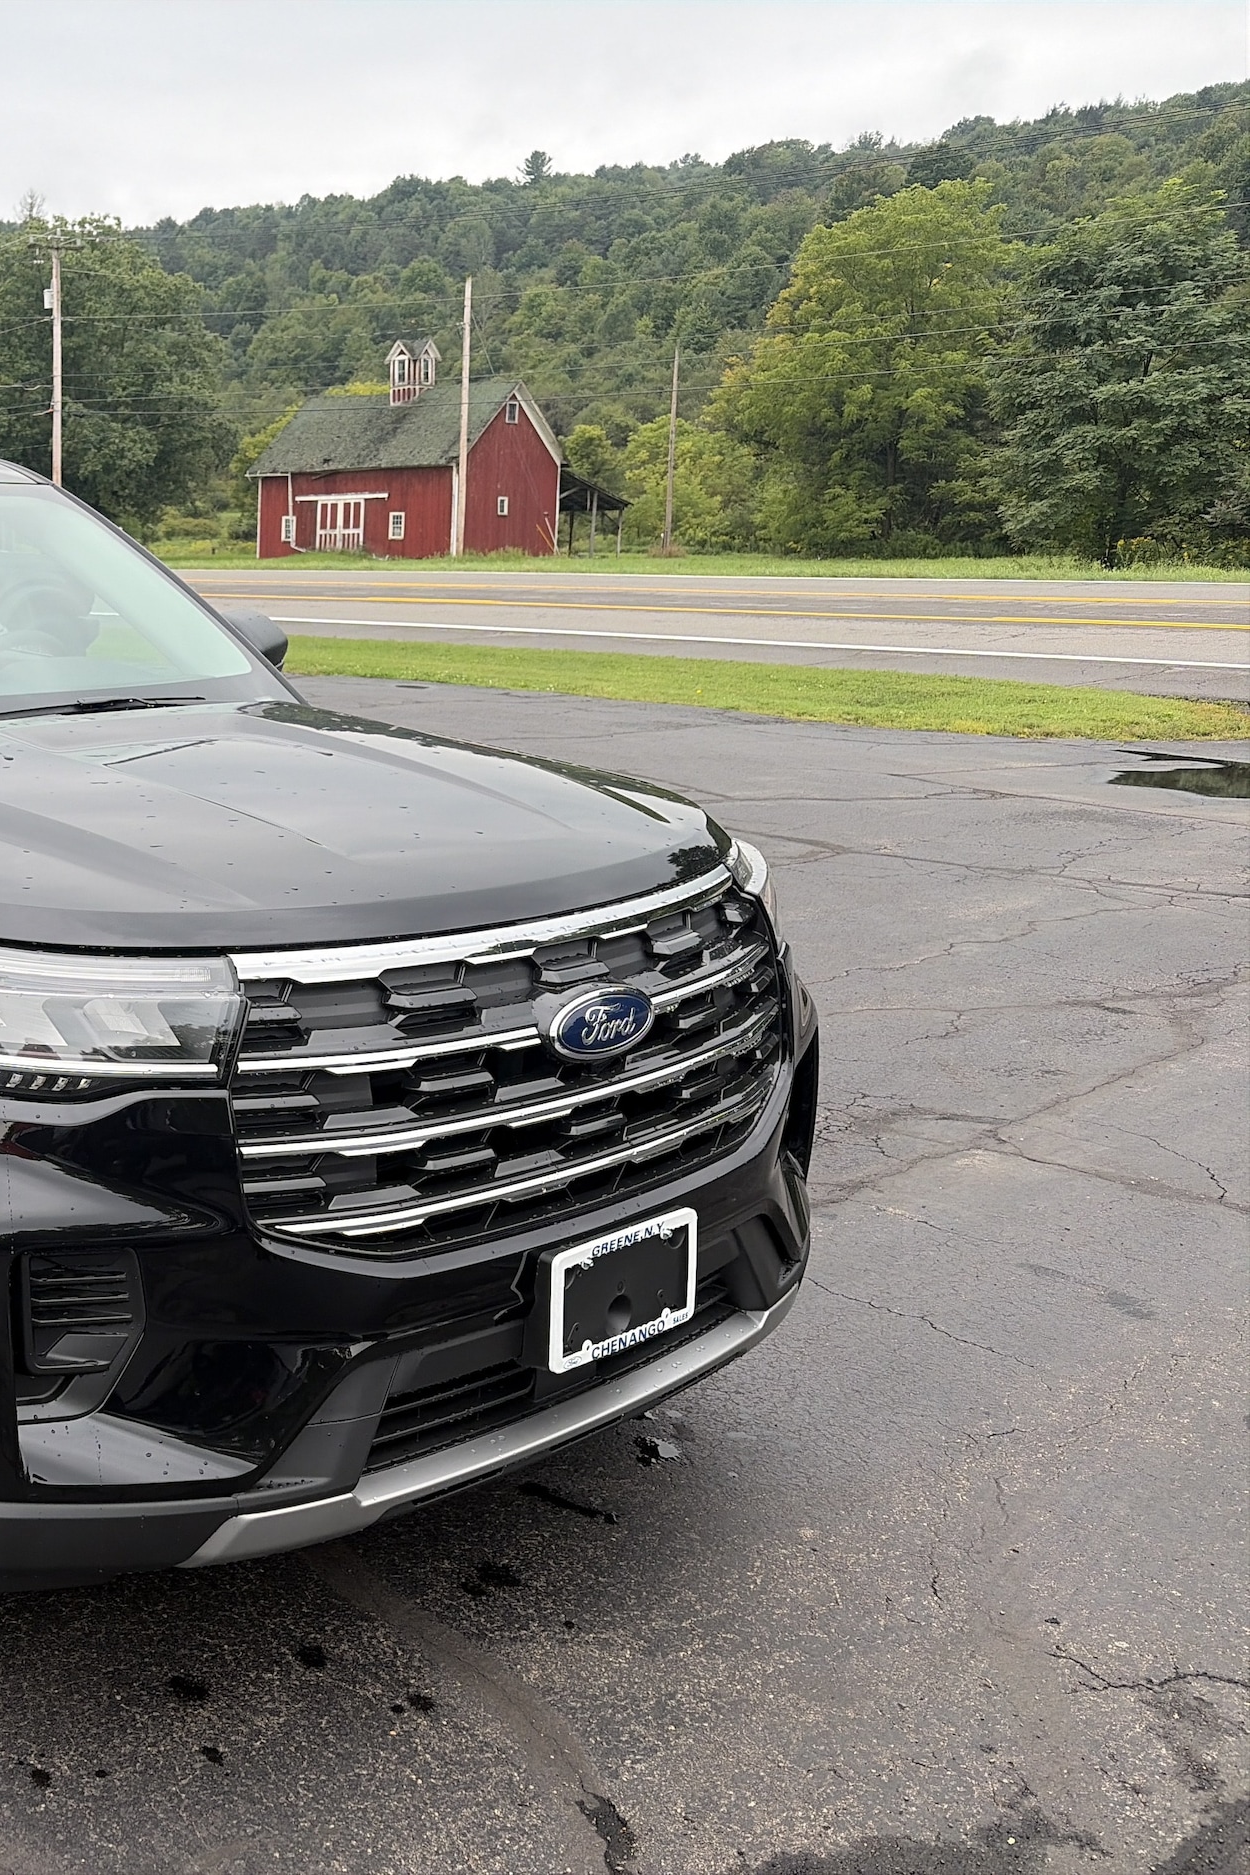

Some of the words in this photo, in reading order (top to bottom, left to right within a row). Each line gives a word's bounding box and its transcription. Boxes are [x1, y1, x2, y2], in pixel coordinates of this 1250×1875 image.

[581, 1003, 636, 1046] Ford
[591, 1320, 665, 1360] CHENANGO
[672, 1312, 689, 1325] SALES
